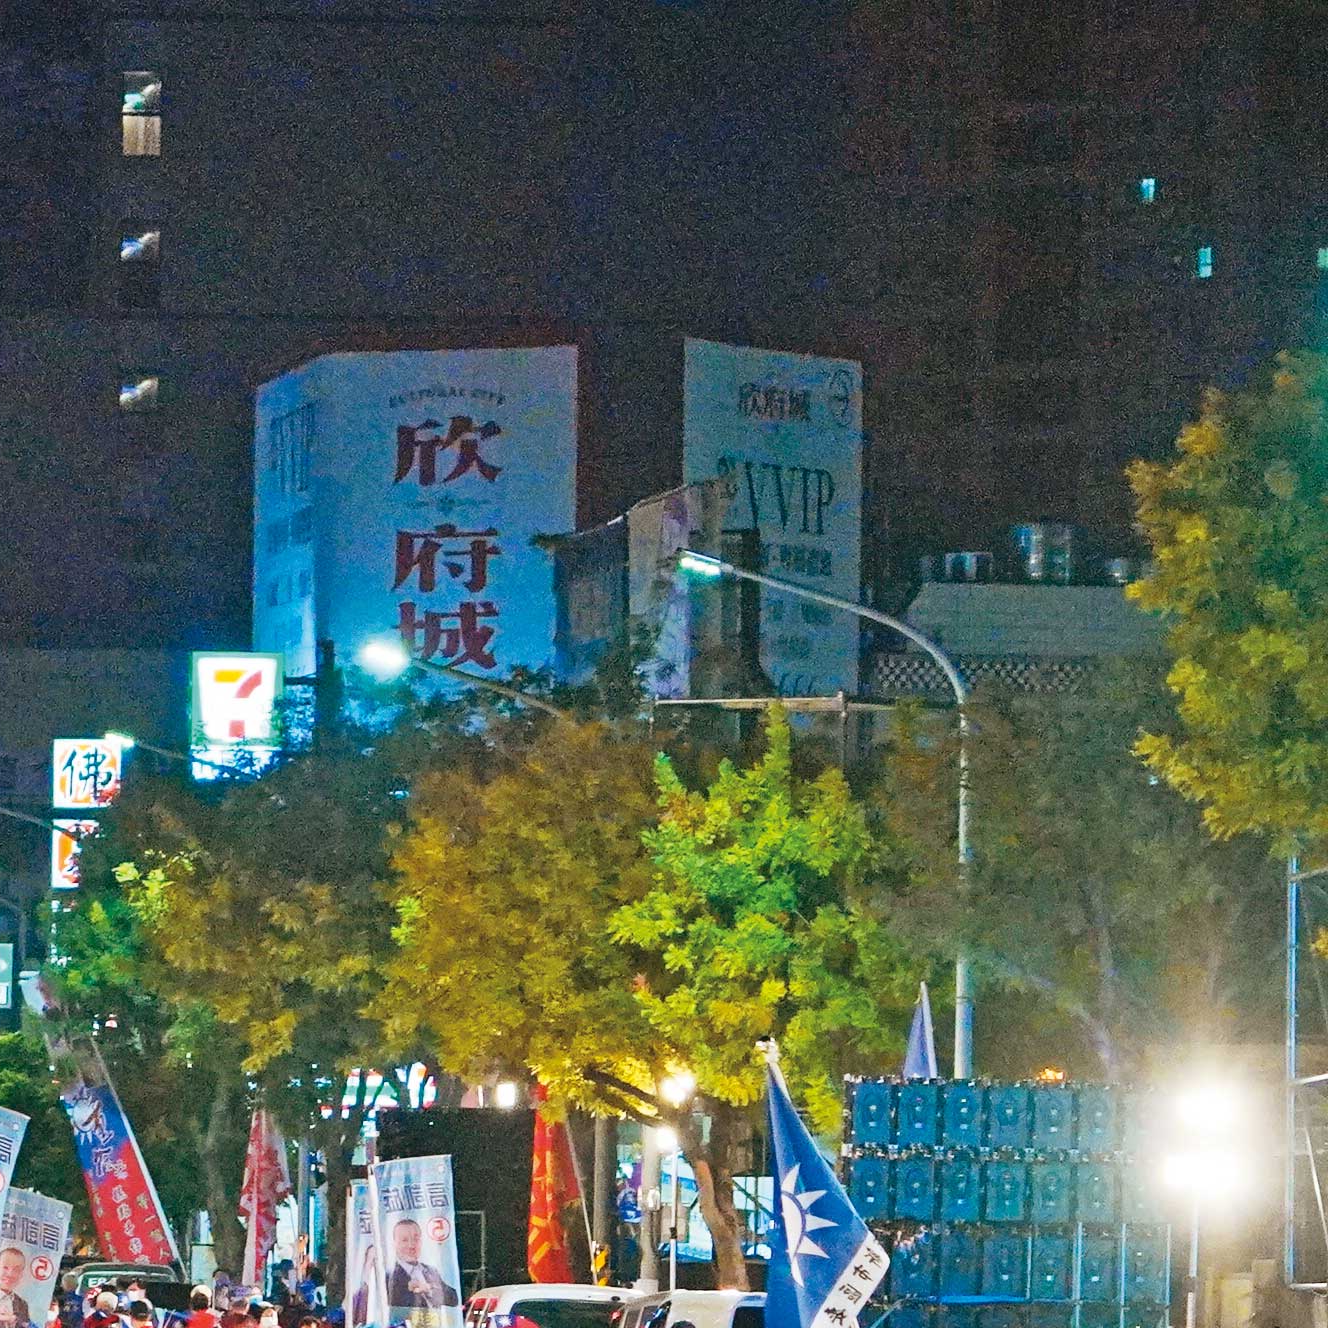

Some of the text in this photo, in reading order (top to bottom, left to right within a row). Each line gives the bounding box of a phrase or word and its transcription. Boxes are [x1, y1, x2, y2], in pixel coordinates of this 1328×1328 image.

[393, 414, 502, 669] 欣府城
[62, 748, 112, 800] 佛
